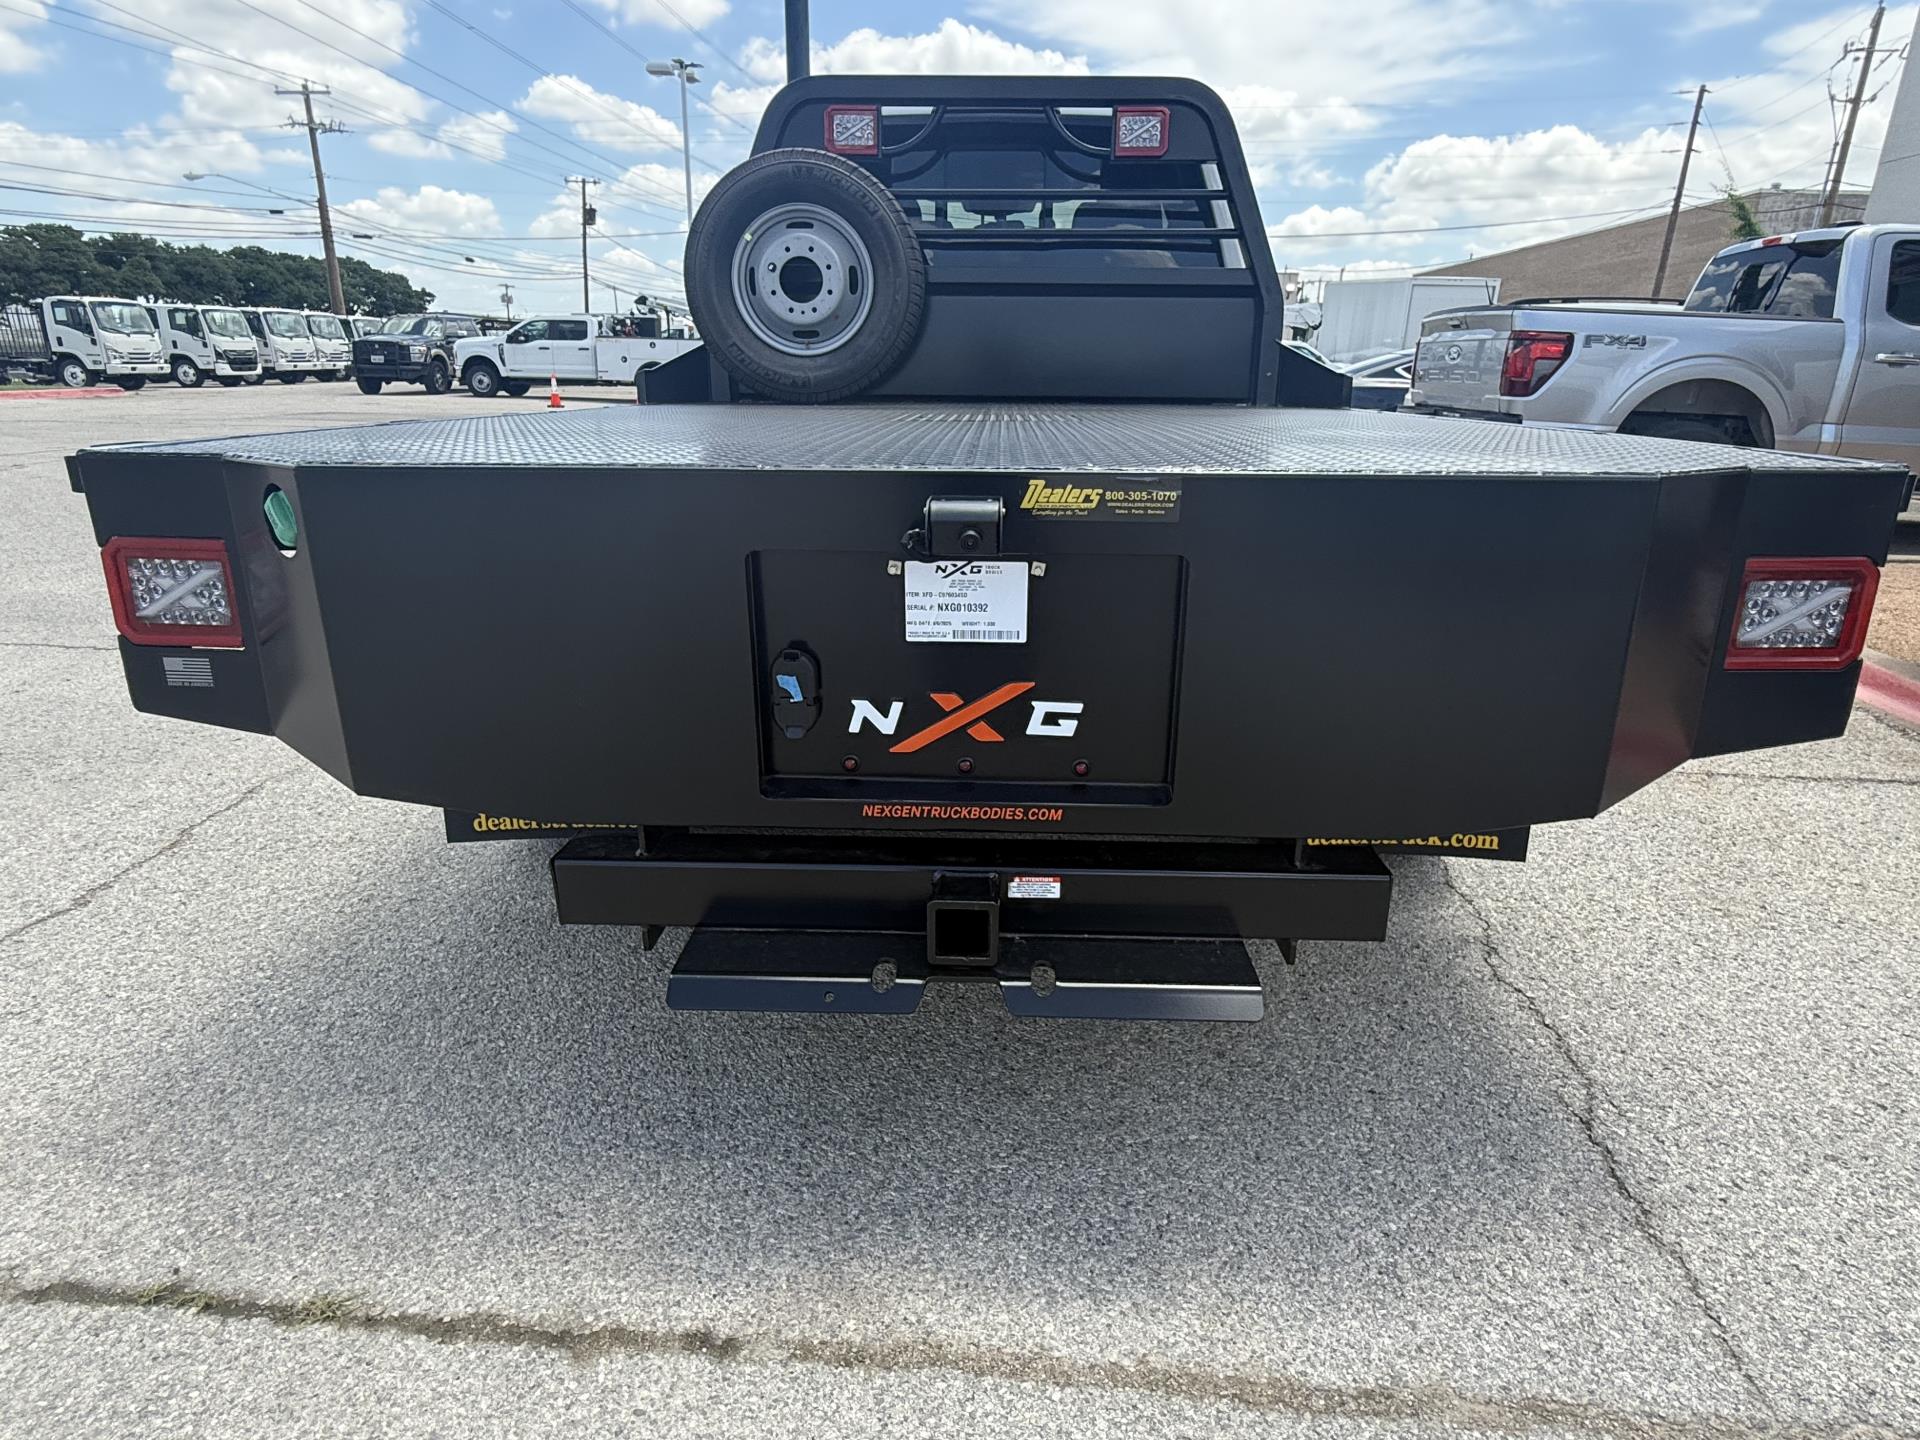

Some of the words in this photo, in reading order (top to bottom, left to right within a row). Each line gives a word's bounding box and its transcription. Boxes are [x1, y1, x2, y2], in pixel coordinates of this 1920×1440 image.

[1582, 334, 1647, 348] FX4
[1020, 479, 1104, 509] Dealers
[1105, 491, 1177, 501] 800-305-1070
[937, 603, 989, 613] NXG010392
[862, 804, 1064, 822] NEXGENTRUCKBODIES.COM
